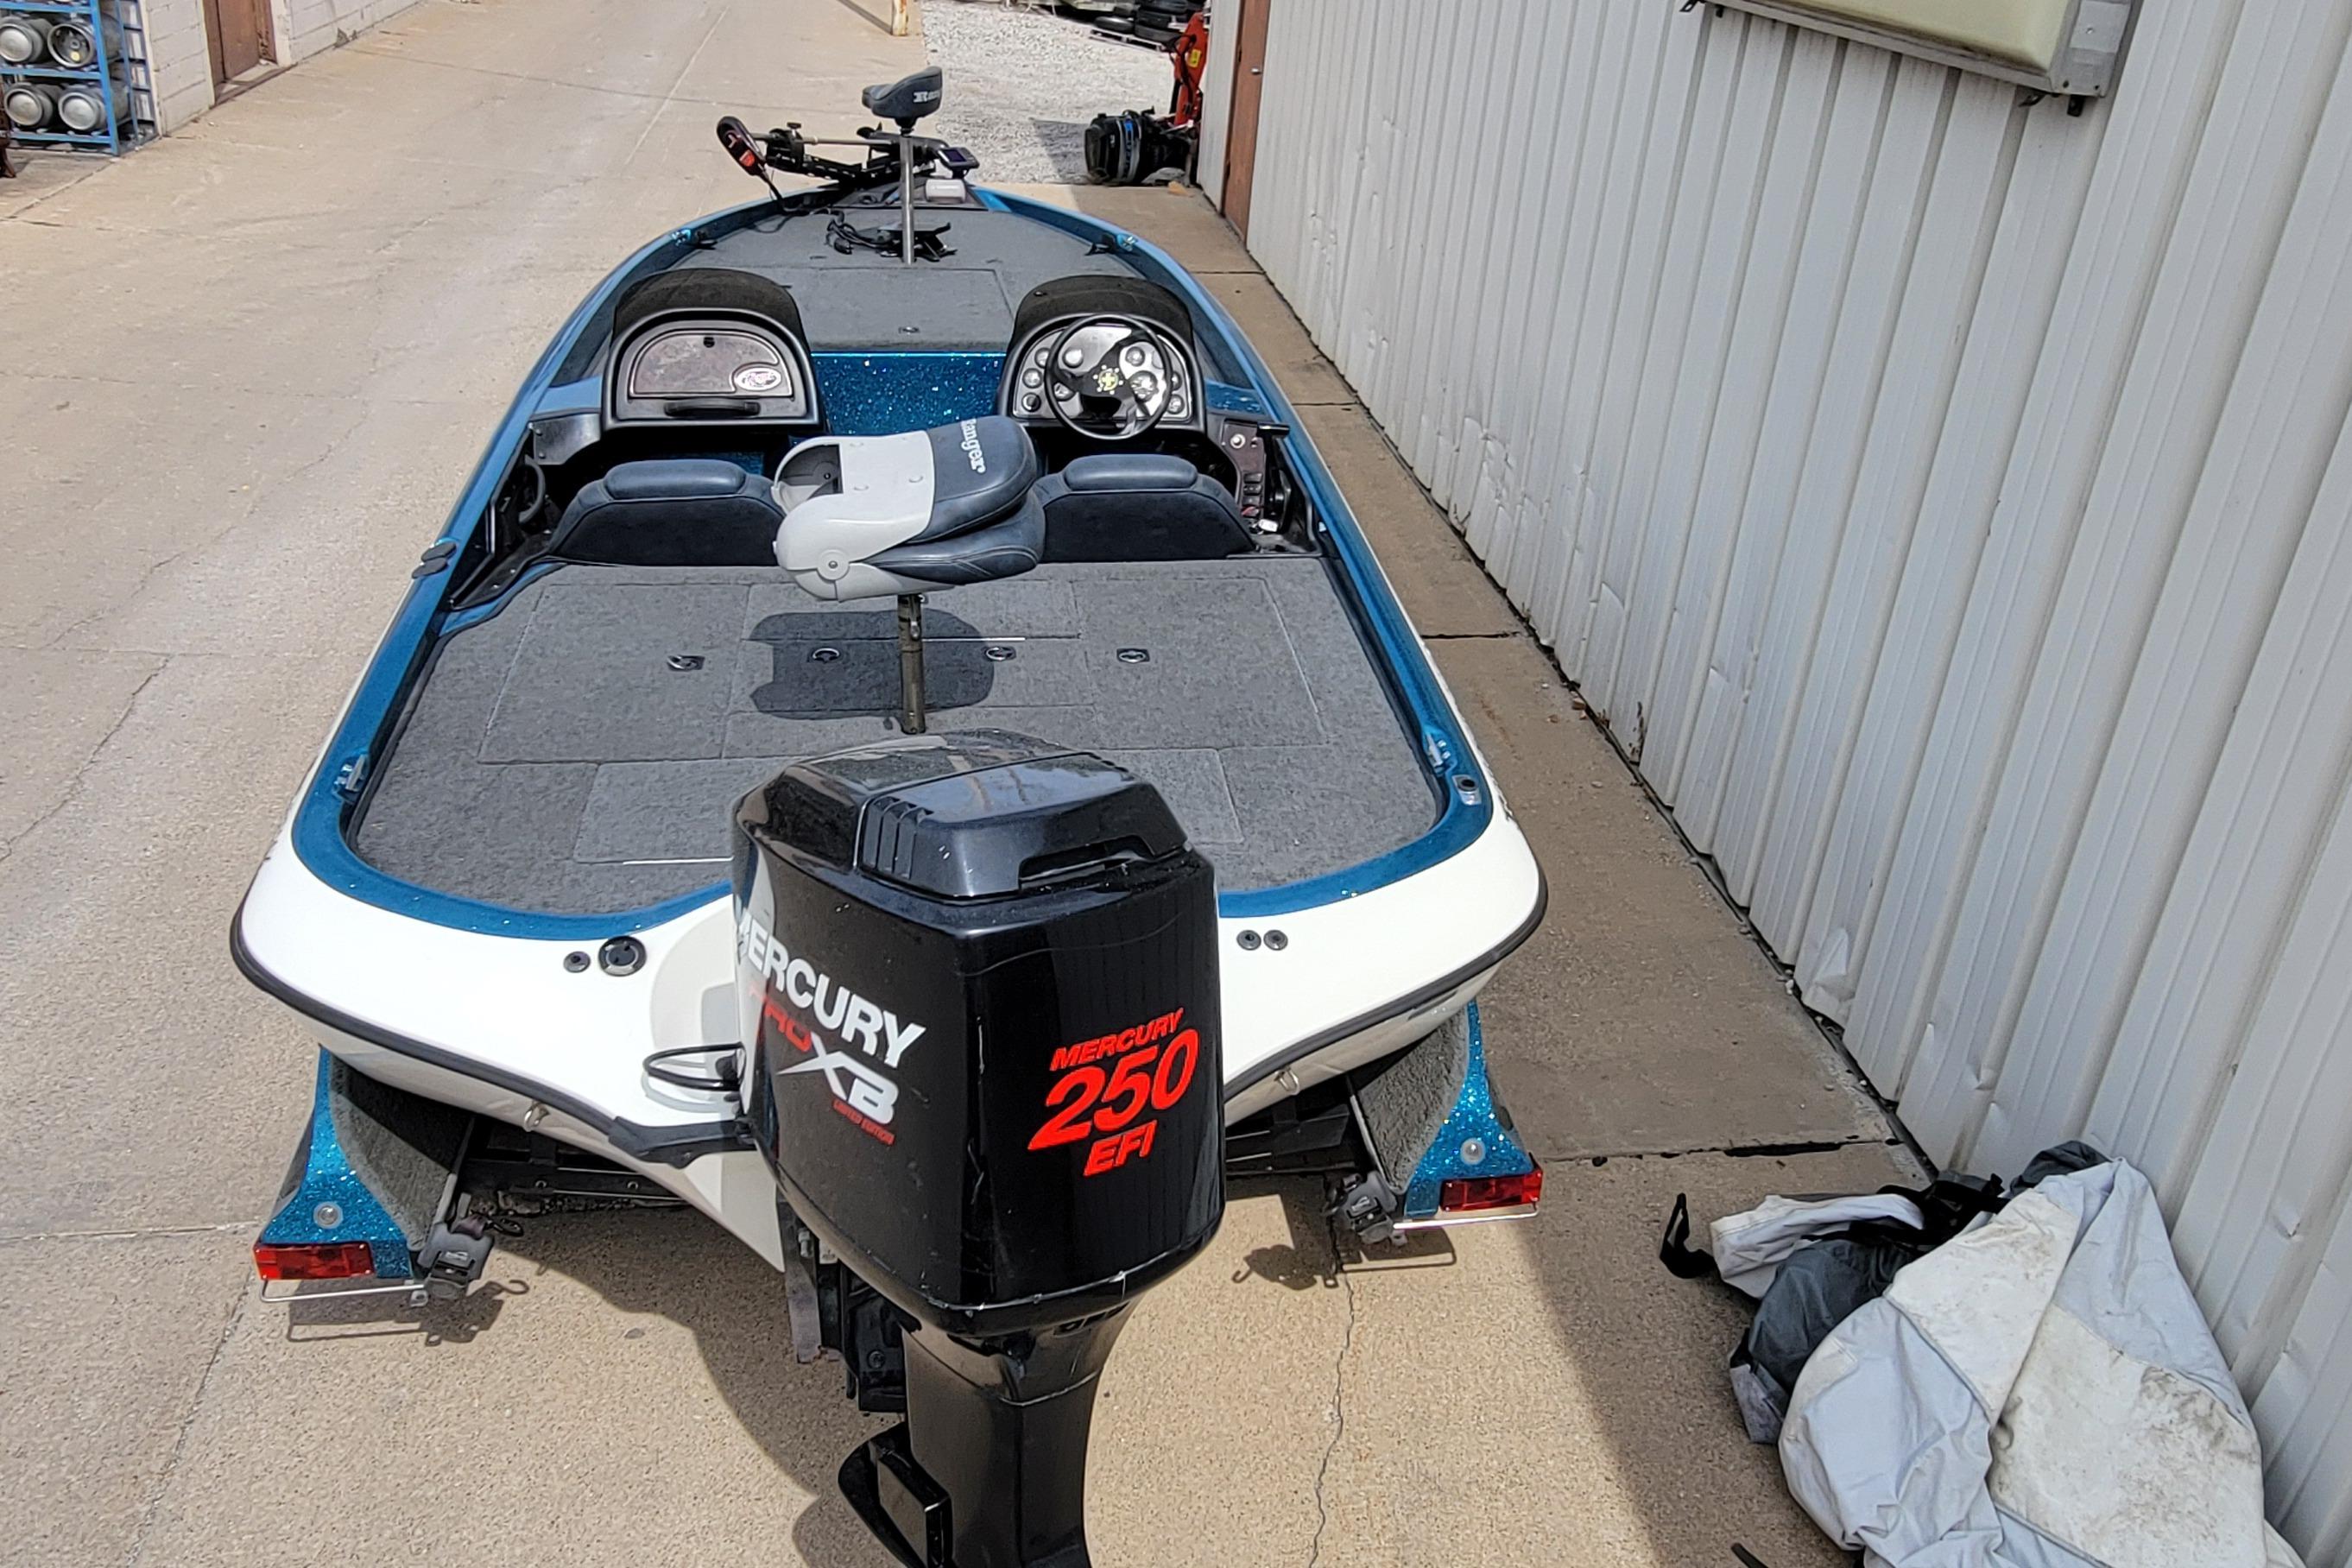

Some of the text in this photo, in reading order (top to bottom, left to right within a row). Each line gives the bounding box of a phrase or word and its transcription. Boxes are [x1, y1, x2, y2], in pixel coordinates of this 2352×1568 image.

[1050, 1007, 1184, 1071] MERCURY
[1027, 1028, 1198, 1150] 250
[1084, 1119, 1157, 1176] EFI
